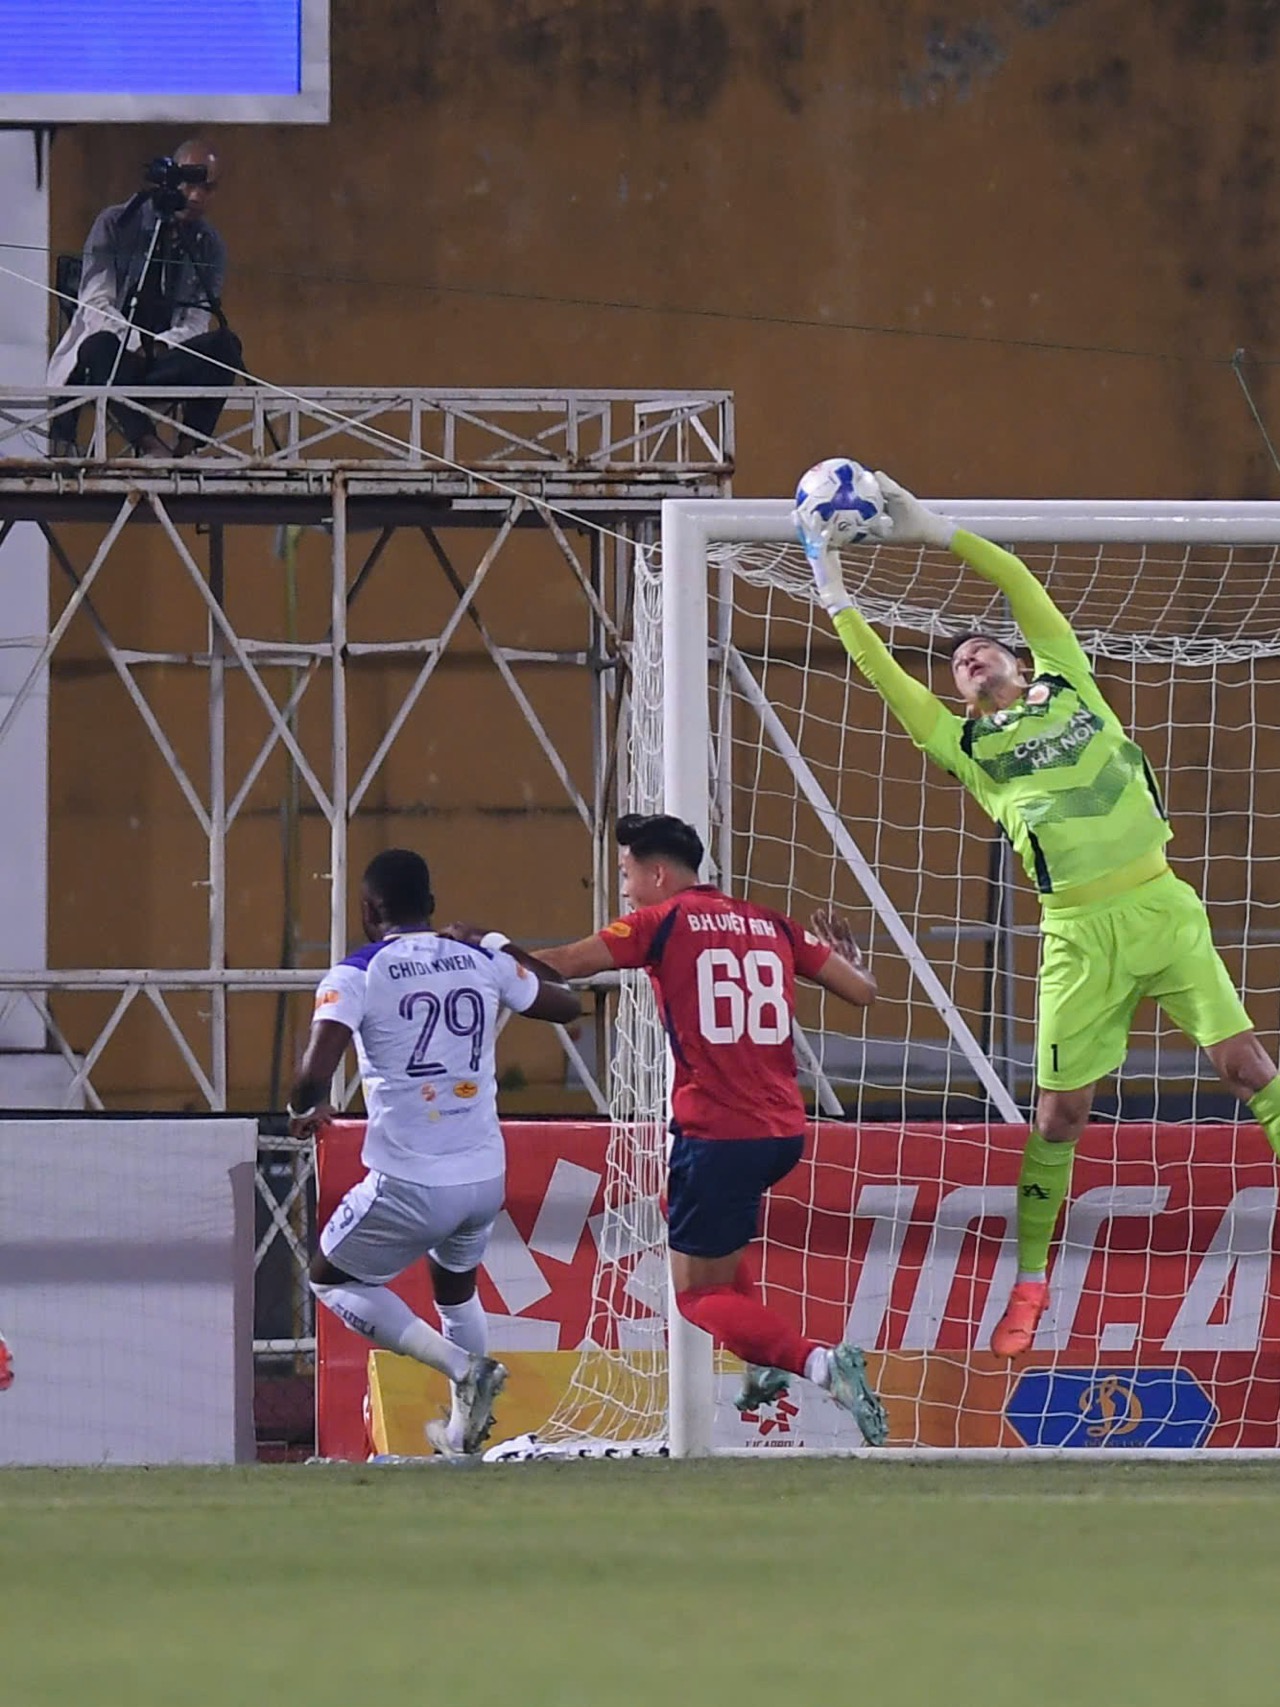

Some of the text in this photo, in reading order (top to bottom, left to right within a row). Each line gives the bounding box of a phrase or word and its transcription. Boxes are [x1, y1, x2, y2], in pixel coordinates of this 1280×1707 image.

[748, 917, 778, 938] ANH
[431, 954, 477, 973] KWEM
[696, 948, 791, 1045] 68
[399, 987, 485, 1078] 29
